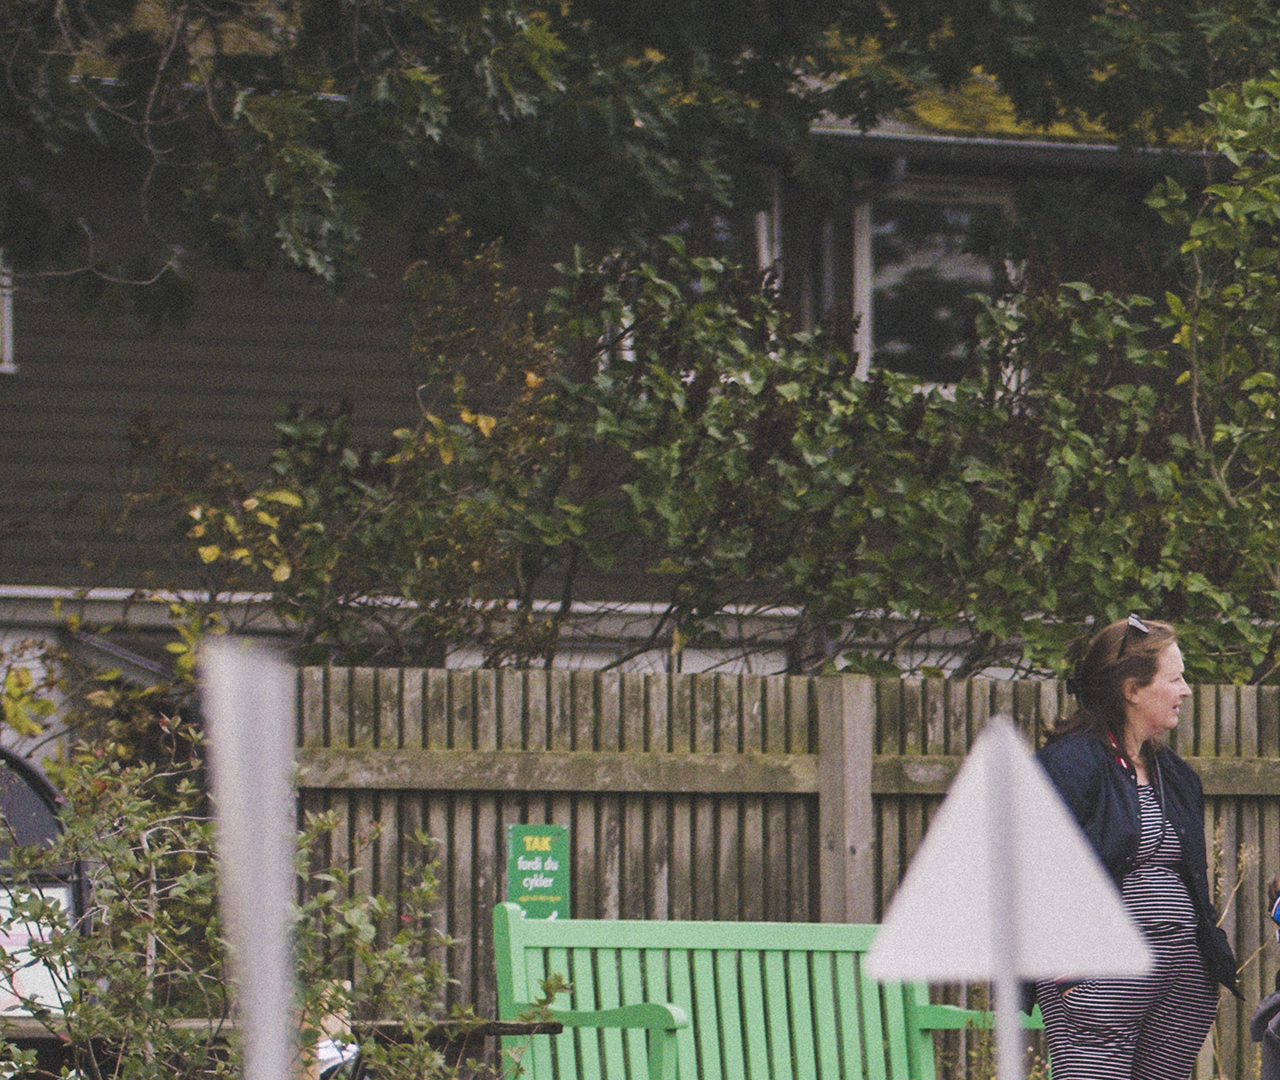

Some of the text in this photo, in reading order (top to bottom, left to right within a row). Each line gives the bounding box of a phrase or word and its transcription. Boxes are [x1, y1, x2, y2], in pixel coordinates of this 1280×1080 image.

[523, 836, 552, 851] TAK
[517, 856, 559, 870] fordi du
[522, 874, 554, 891] cykler
